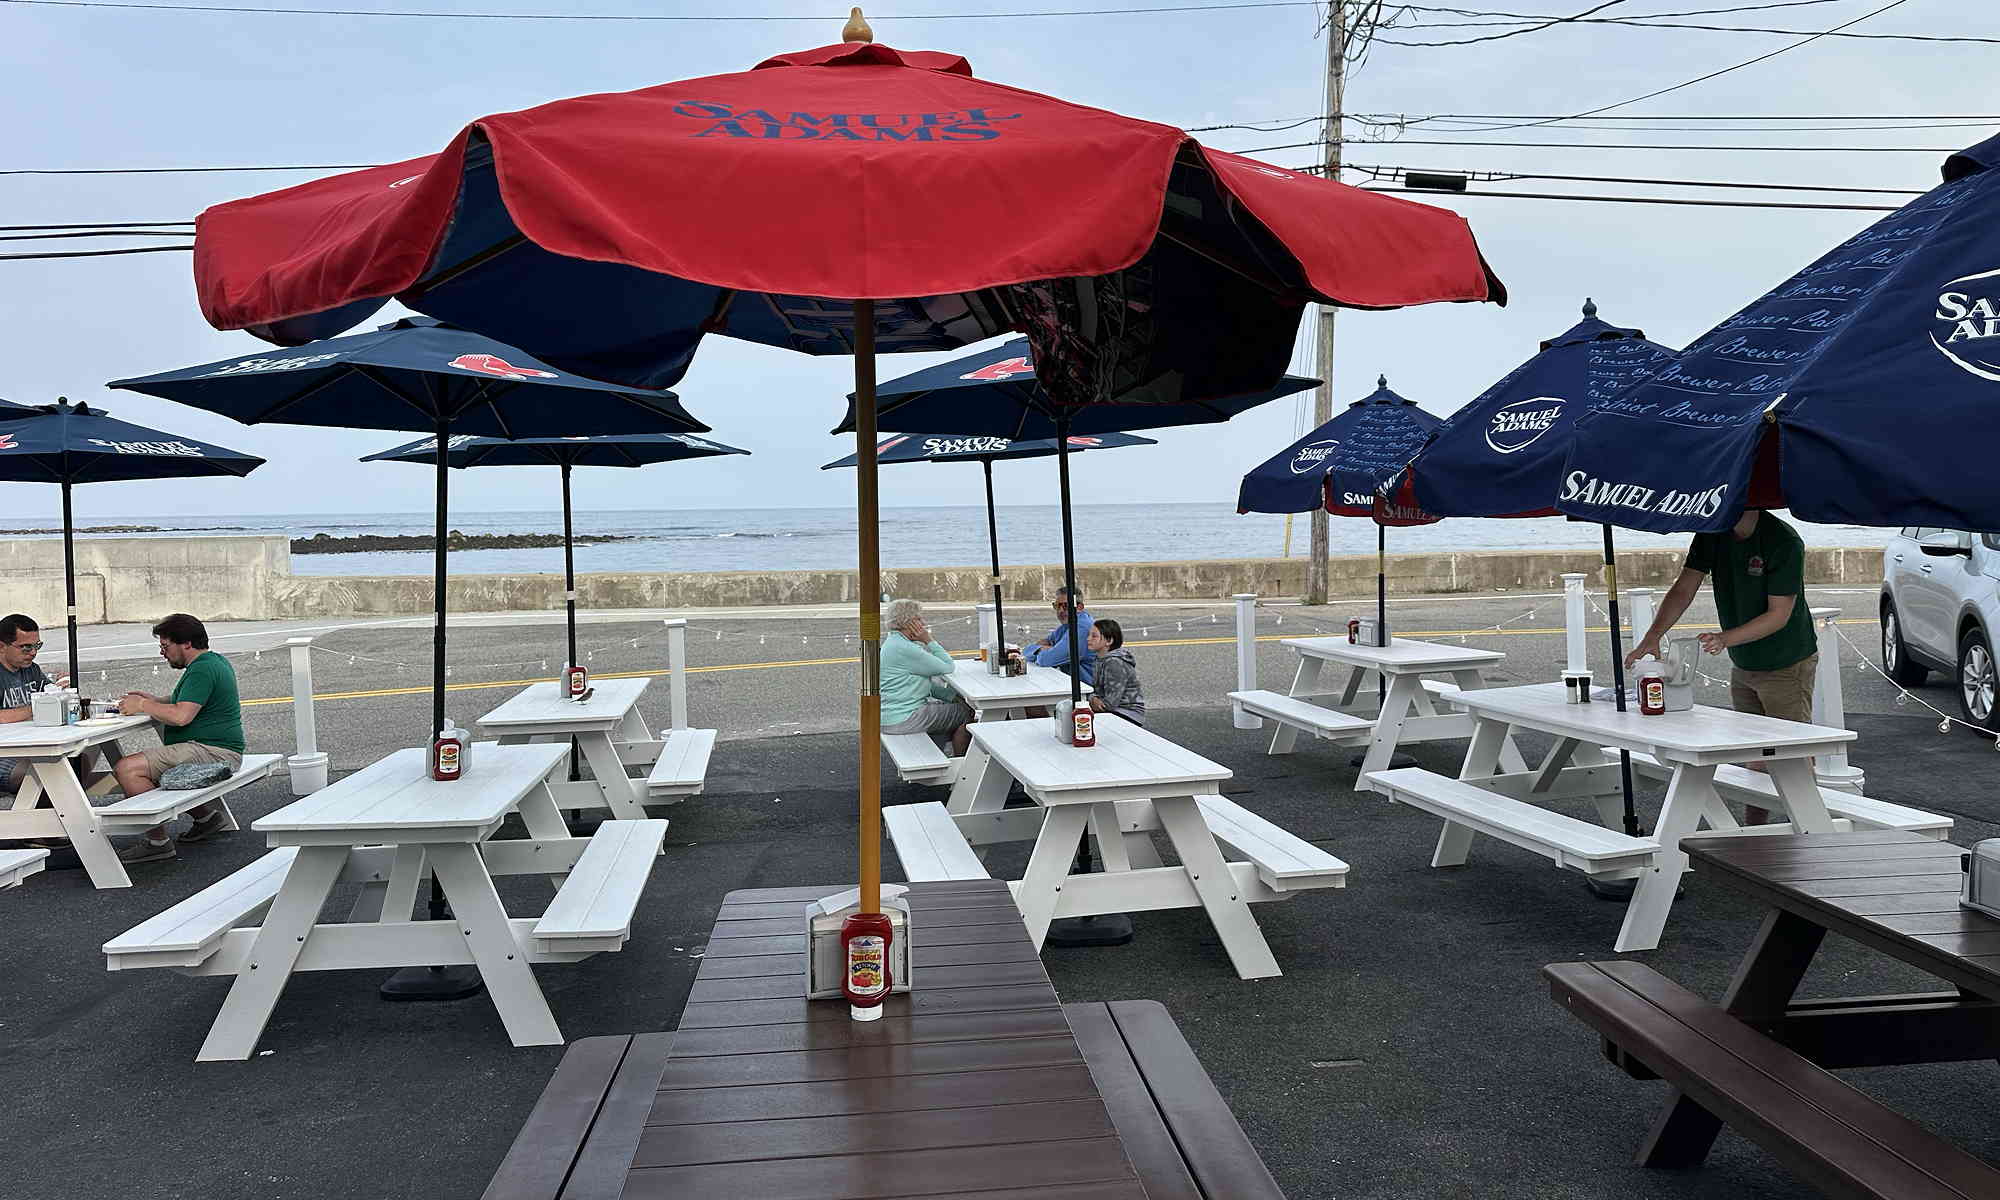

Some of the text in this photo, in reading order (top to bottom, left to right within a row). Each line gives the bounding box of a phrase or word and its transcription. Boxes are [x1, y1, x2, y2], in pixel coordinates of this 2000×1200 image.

[672, 99, 1024, 127] SAMUEL
[688, 121, 1001, 141] ADAMS
[1935, 291, 2000, 321] SA
[1655, 362, 1732, 390] Brewer
[1491, 405, 1562, 424] SAMUEL
[1659, 400, 1742, 424] Brewer
[1490, 418, 1552, 434] ADAMS
[1344, 493, 1375, 505] SAM
[1559, 470, 1729, 519] SAMUEL ADAMS
